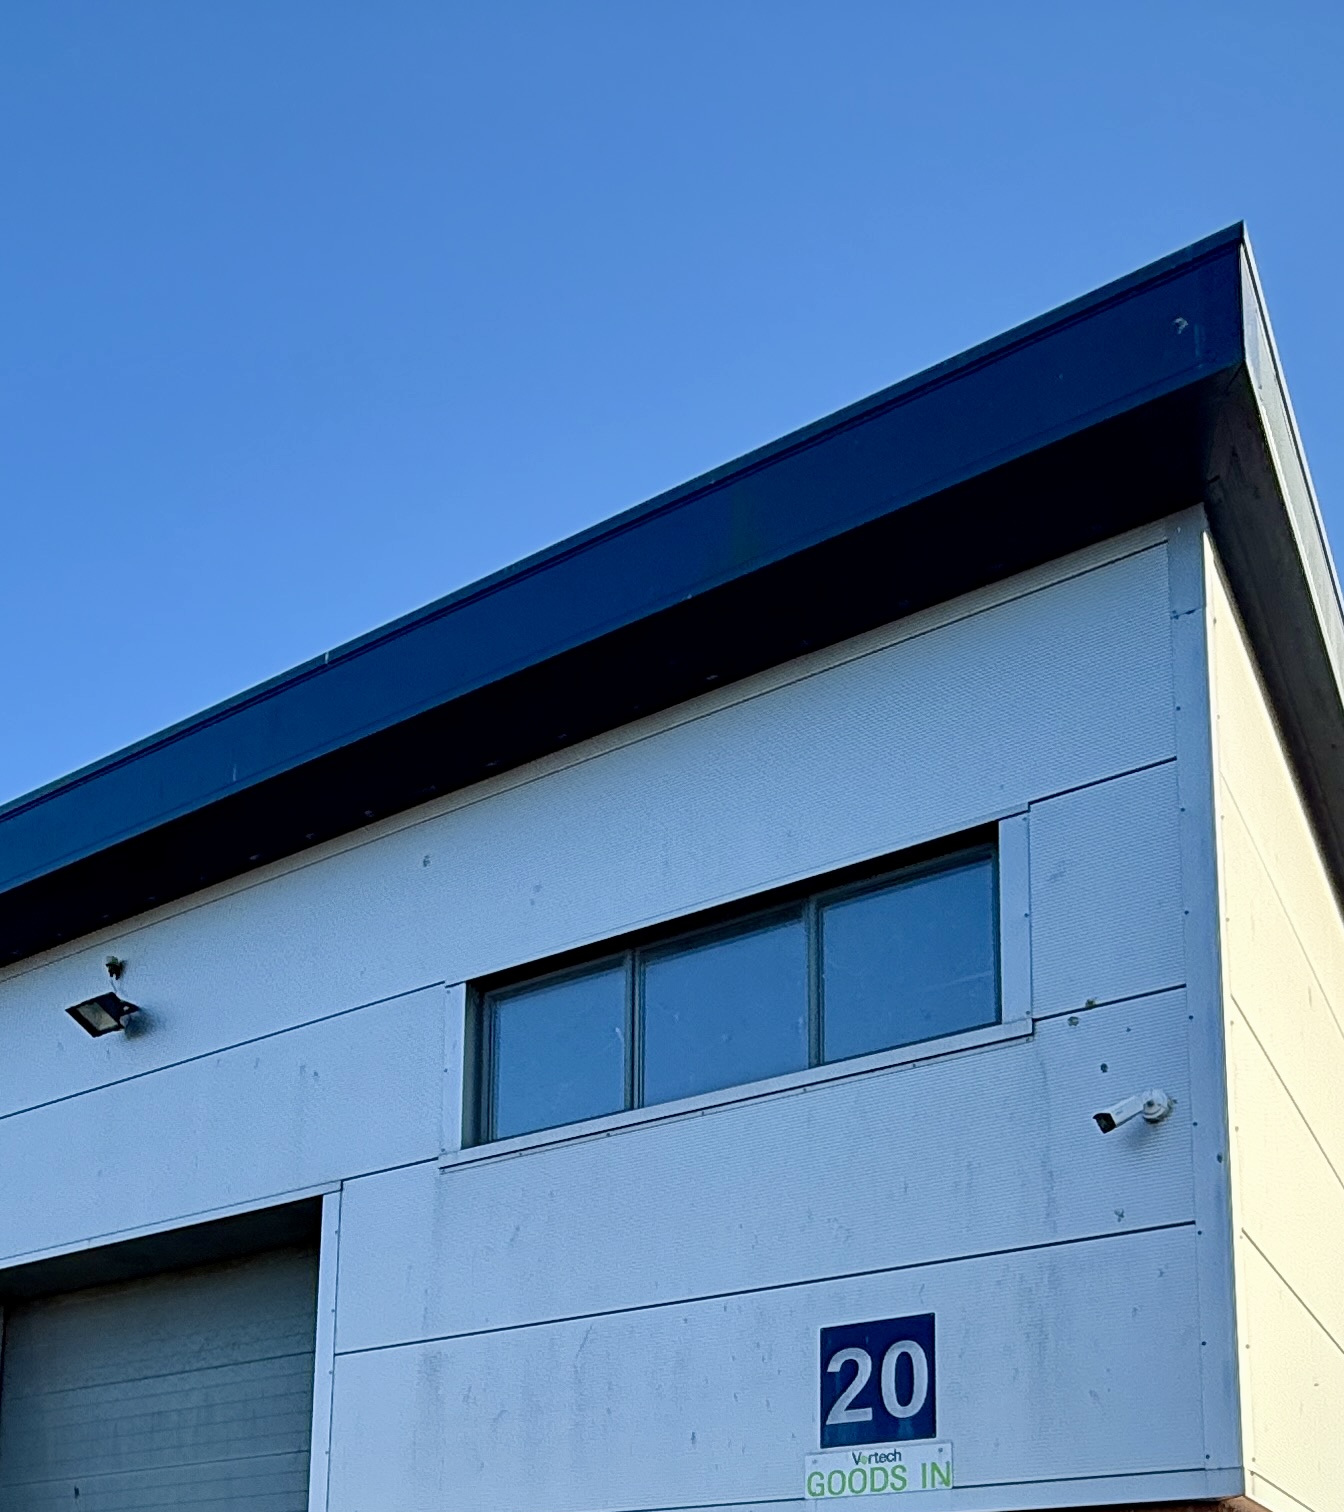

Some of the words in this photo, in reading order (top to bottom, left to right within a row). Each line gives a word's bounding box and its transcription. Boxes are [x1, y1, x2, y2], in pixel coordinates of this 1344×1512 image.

[826, 1340, 928, 1425] 20
[852, 1449, 902, 1466] Vortech
[807, 1465, 907, 1497] GOODS
[921, 1461, 951, 1488] IN
